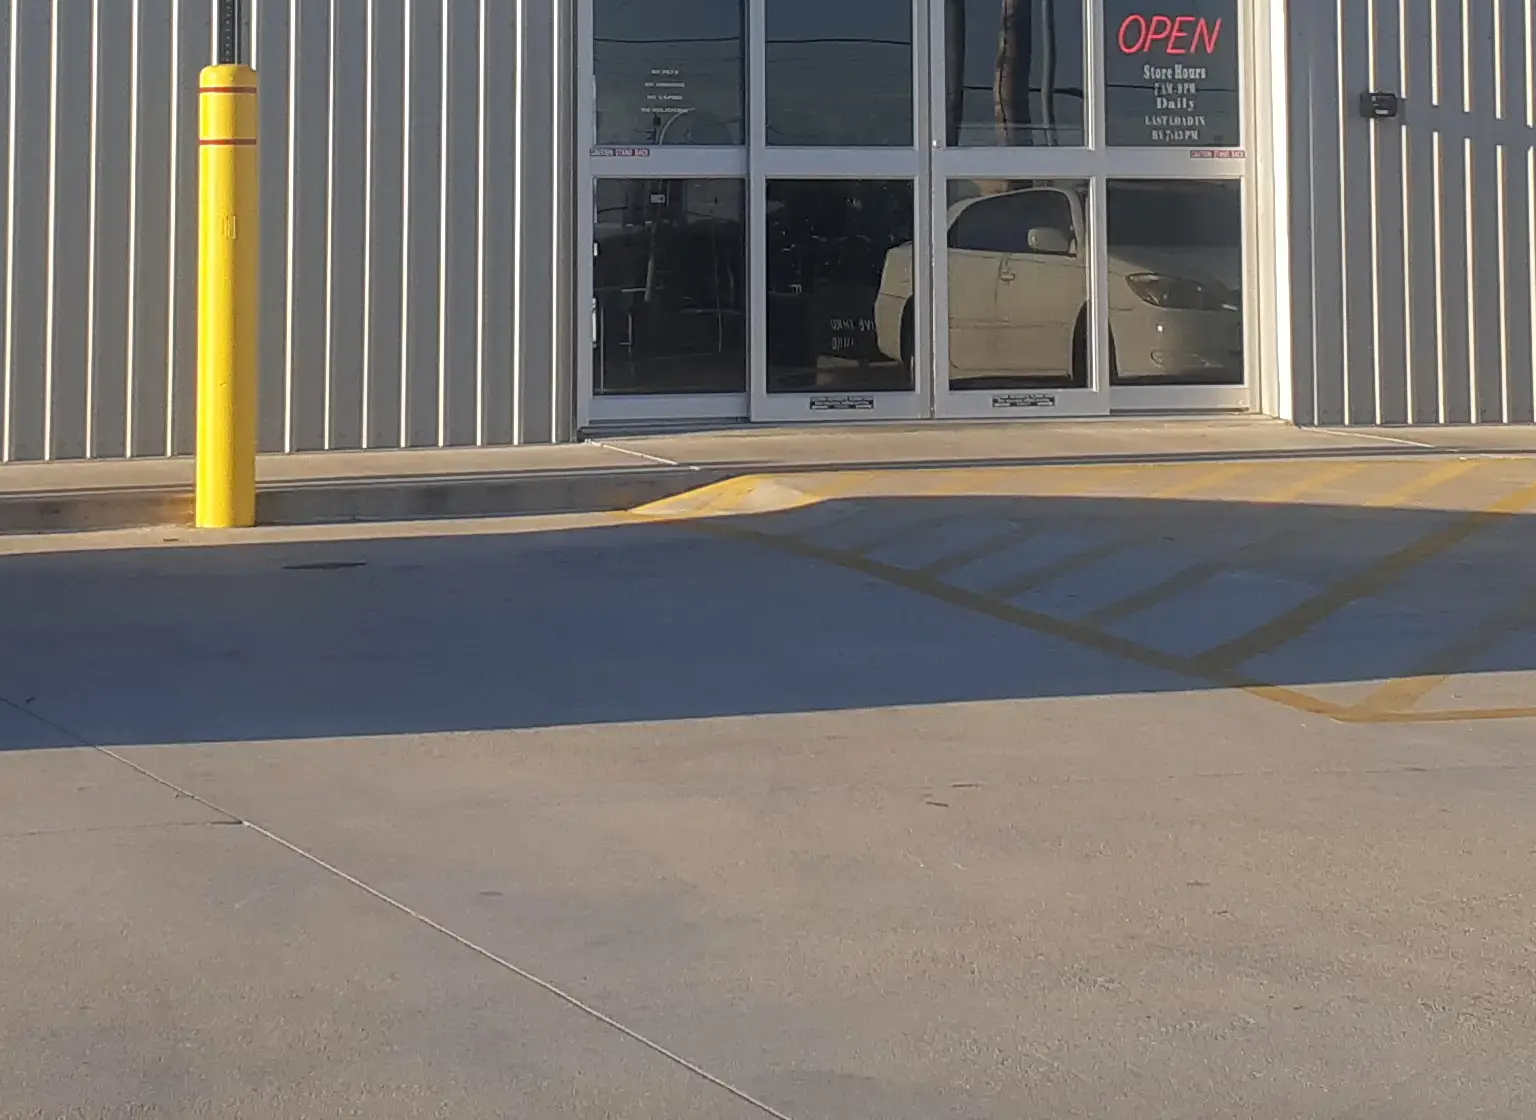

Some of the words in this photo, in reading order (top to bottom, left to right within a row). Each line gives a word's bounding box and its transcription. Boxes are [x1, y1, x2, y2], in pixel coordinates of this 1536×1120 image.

[1117, 13, 1223, 55] OPEN
[1143, 64, 1173, 80] Store
[1174, 63, 1206, 79] Hours
[1156, 97, 1195, 112] Daily
